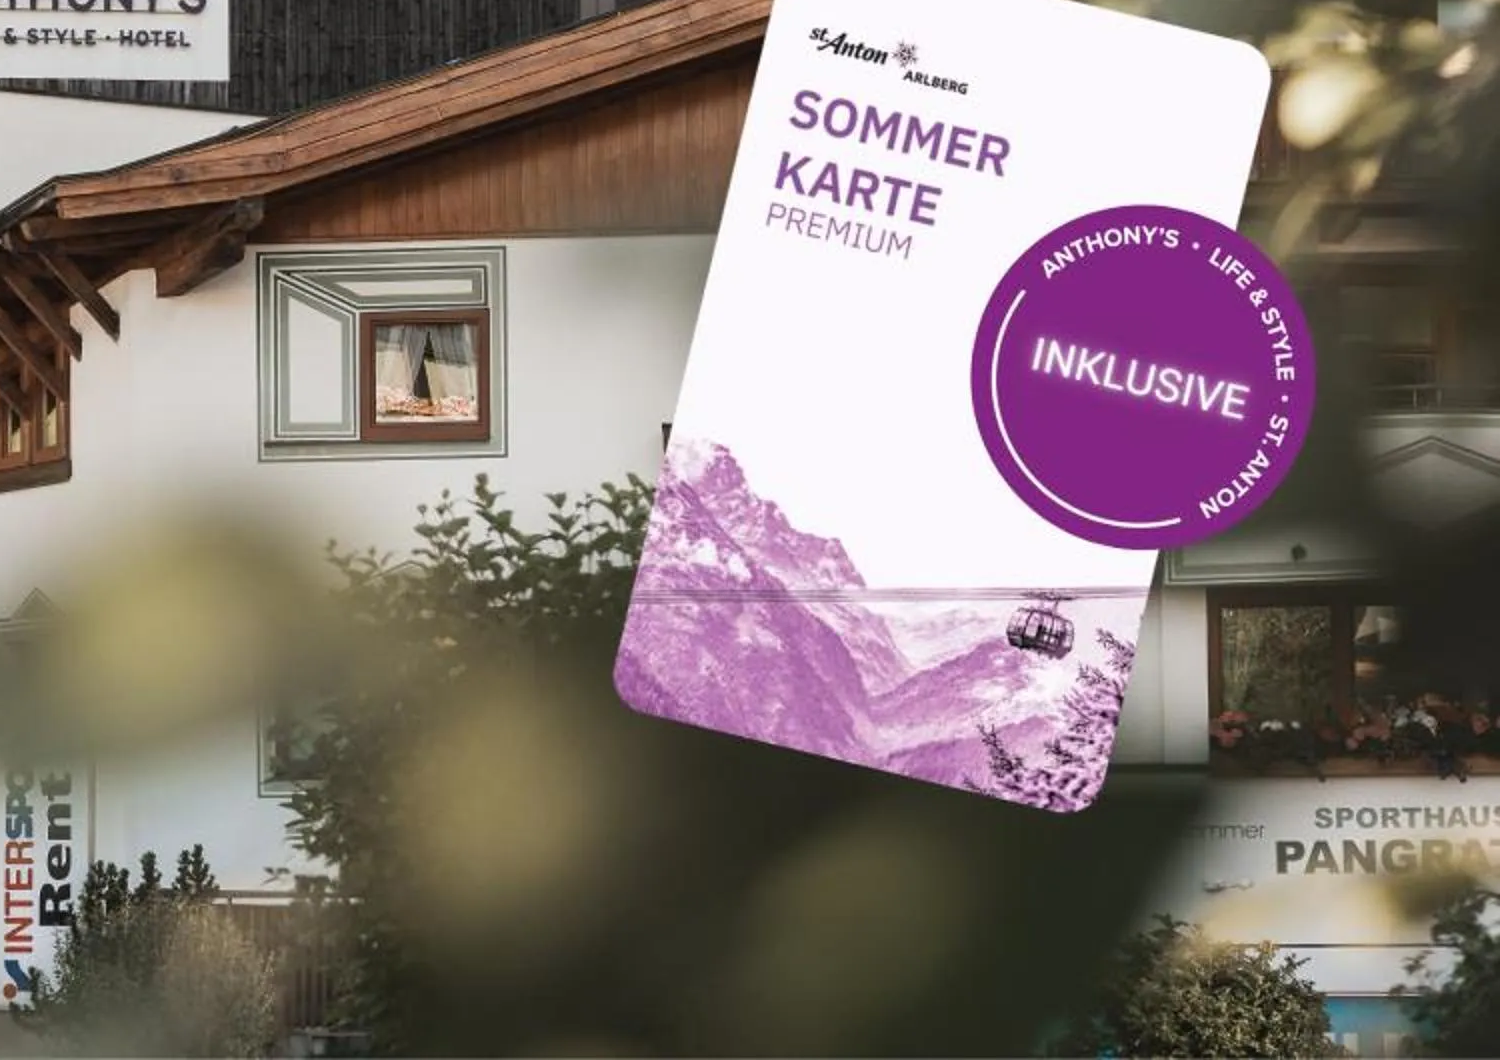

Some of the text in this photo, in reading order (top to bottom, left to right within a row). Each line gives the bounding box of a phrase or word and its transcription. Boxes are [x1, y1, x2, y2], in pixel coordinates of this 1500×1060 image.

[4, 28, 17, 44] &
[27, 28, 96, 47] STYLE
[119, 30, 190, 48] HOTEL
[4, 768, 34, 954] INTERSPO
[40, 770, 72, 927] Rent
